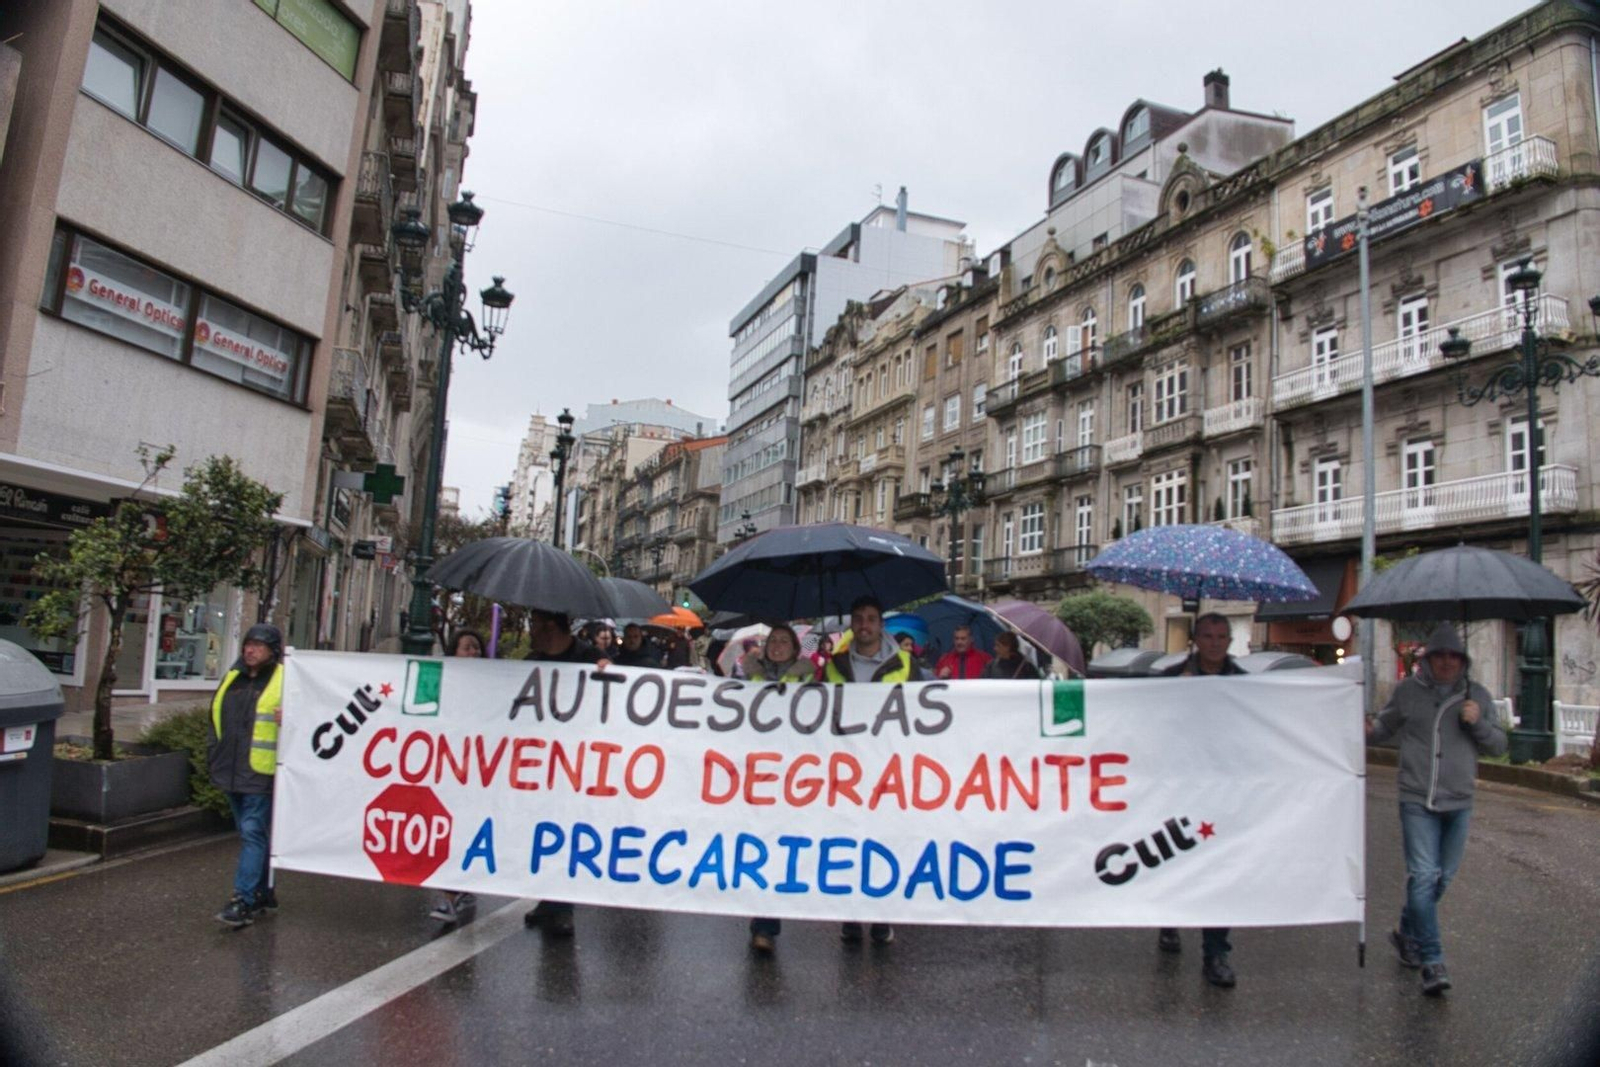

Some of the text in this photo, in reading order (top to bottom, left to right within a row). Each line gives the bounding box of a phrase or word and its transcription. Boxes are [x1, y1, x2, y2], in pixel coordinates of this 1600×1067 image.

[89, 278, 140, 313] General
[213, 331, 254, 359] General
[402, 661, 438, 715] L
[509, 667, 953, 737] AUTOESCOLAS
[1042, 680, 1083, 736] L
[363, 727, 1129, 812] CONVENIO DEGRADANTE
[364, 808, 451, 858] STOP
[461, 817, 1035, 901] A PRECARIEDADE
